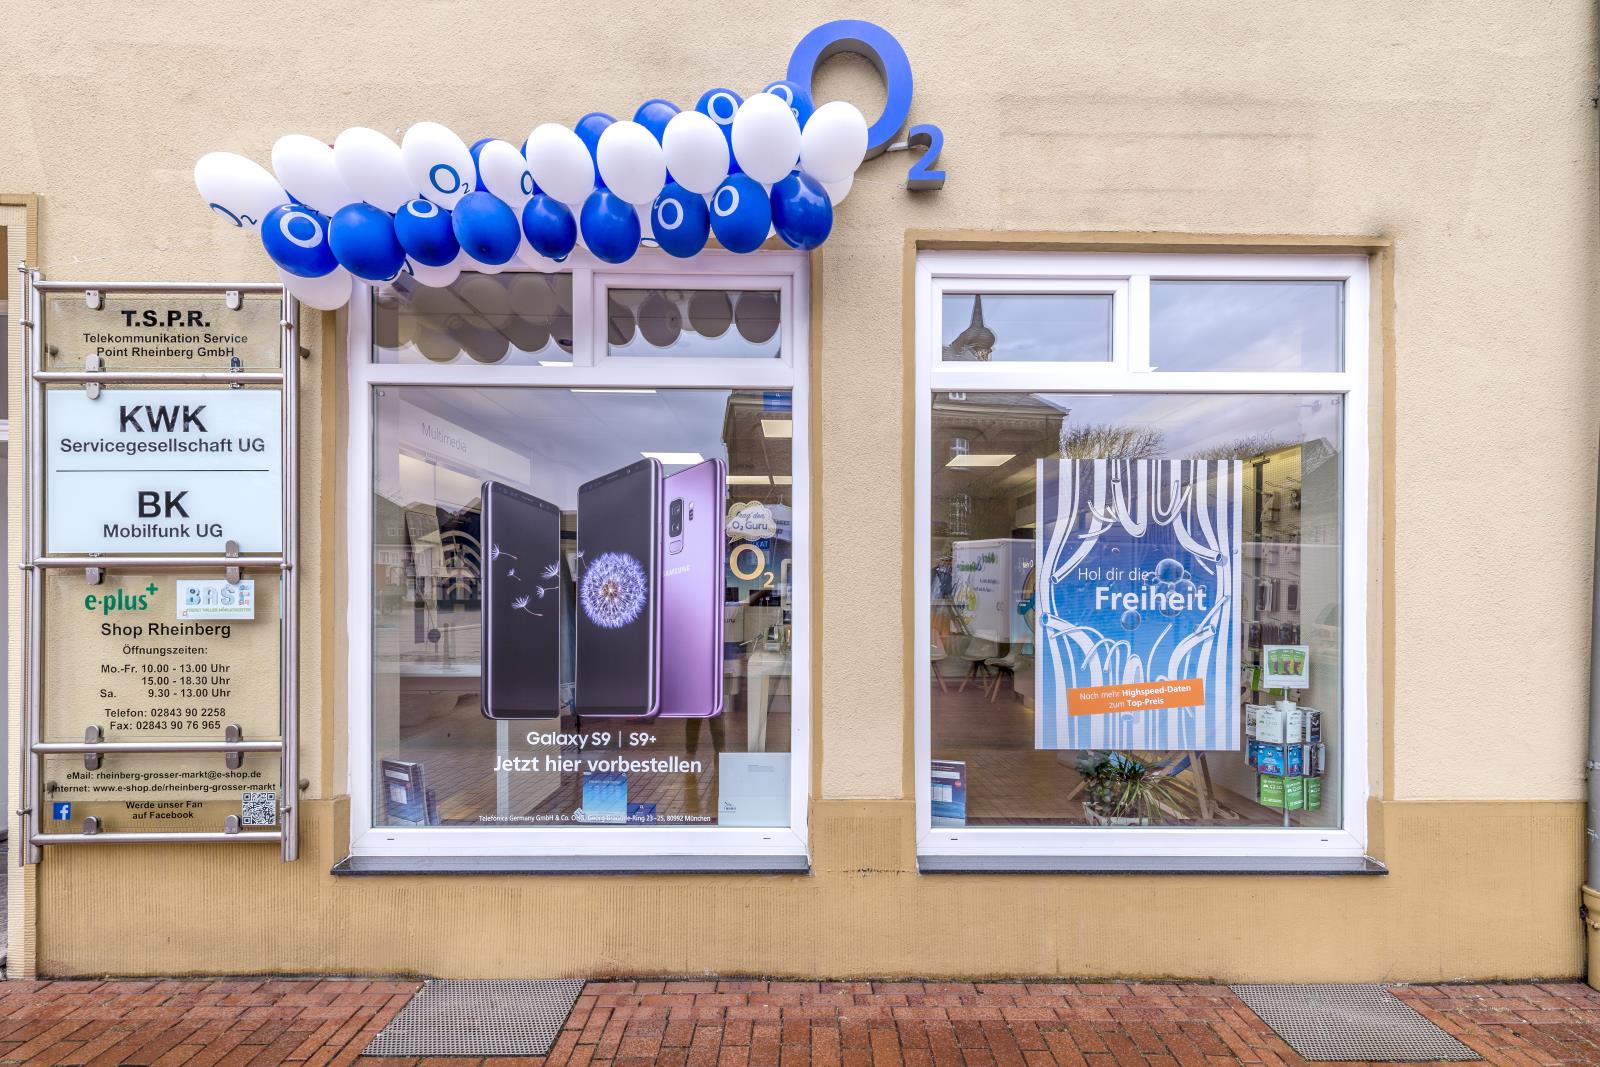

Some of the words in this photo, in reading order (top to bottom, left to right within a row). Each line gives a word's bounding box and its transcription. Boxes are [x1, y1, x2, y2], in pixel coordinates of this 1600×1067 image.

[429, 163, 471, 195] O2
[120, 309, 211, 328] T.S.P.R.
[83, 333, 200, 344] Telekommunikation
[203, 333, 249, 344] Service
[97, 347, 129, 357] Point
[131, 347, 194, 360] Rheinberg
[197, 347, 235, 358] GmbH
[119, 405, 208, 433] KWK
[422, 421, 467, 453] Multimedia
[60, 438, 233, 455] Servicegesellschaft
[238, 438, 265, 453] UG
[138, 490, 190, 518] BK
[103, 523, 190, 538] Mobilfunk
[196, 523, 223, 538] UG
[745, 522, 768, 530] Guru
[729, 543, 775, 588] O2
[1078, 567, 1101, 581] Hol
[1105, 567, 1124, 581] dir
[1128, 567, 1150, 581] die
[1095, 586, 1207, 611] Freiheit
[101, 623, 143, 639] Shop
[148, 623, 231, 639] Rheinberg
[122, 644, 208, 657] Öffnungszeiten:
[101, 664, 138, 674] Mo.-Fr.
[142, 664, 169, 673] 10.00
[180, 664, 208, 673] 13.00
[211, 664, 231, 673] Uhr
[142, 676, 169, 685] 15.00
[180, 676, 208, 685] 18.30
[211, 676, 231, 685] Uhr
[100, 689, 117, 698] Sa.
[148, 688, 170, 698] 9.30
[180, 688, 208, 698] 13.00
[211, 688, 231, 698] Uhr
[1079, 691, 1099, 701] Noch
[1122, 684, 1192, 698] Highspeed-Daten
[1126, 697, 1165, 708] Top-Preis
[105, 708, 147, 718] Telefon:
[150, 708, 182, 717] 02843
[185, 708, 198, 717] 90
[201, 708, 226, 717] 2258
[110, 721, 132, 730] Fax:
[136, 721, 168, 730] 02843
[170, 721, 183, 730] 90
[186, 720, 199, 730] 76
[202, 720, 221, 730] 965
[526, 731, 589, 749] Galaxy
[592, 732, 611, 746] S9
[629, 732, 657, 746] S9+
[493, 755, 540, 772] Jetzt
[545, 754, 582, 772] hier
[587, 755, 702, 773] vorbestellen
[66, 772, 94, 780] eMail:
[96, 771, 262, 781] rheinberg-grosser-markt@e-shop.de
[93, 783, 276, 793] www.e-shop.de/rheinberg-grosser-markt
[126, 801, 155, 809] Werde
[157, 801, 183, 809] unser
[186, 800, 203, 809] Fan
[132, 811, 148, 820] auf
[149, 811, 194, 820] Facebook
[509, 815, 535, 823] Germany
[684, 814, 711, 822] München
